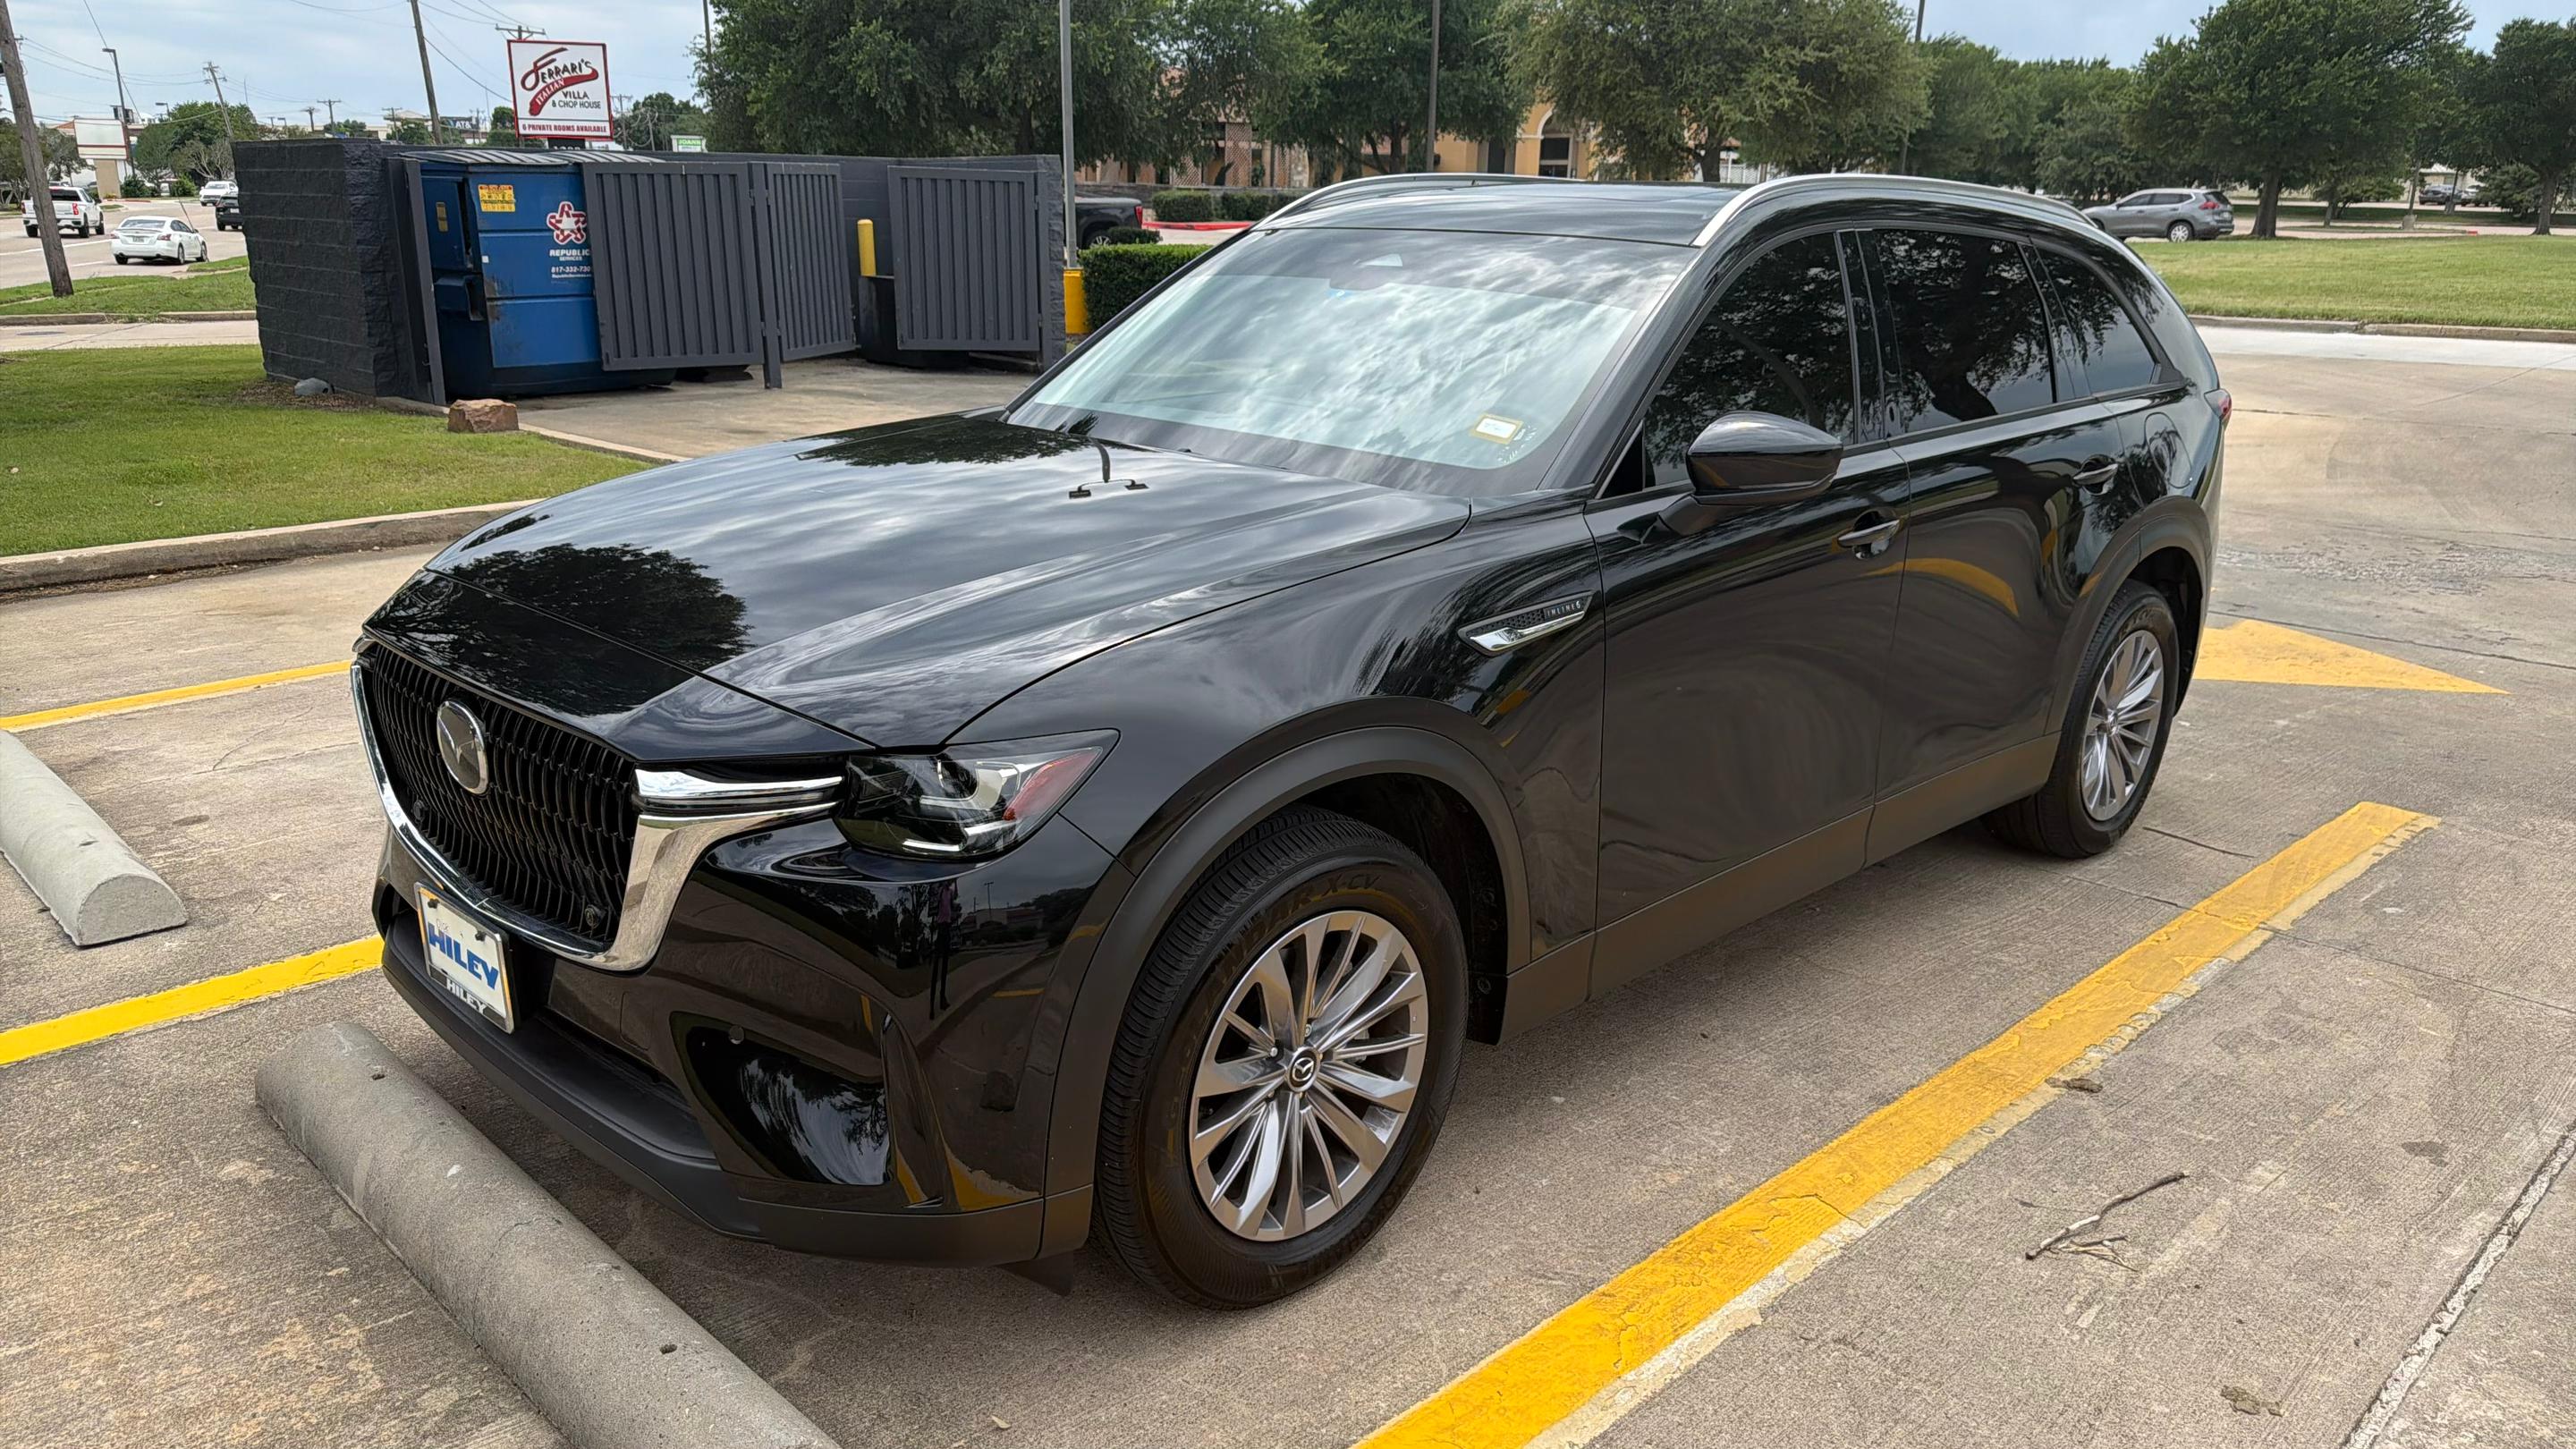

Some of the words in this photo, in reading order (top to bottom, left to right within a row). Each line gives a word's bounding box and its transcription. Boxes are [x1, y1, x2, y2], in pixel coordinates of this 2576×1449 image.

[535, 78, 565, 106] ITALIAN
[561, 90, 590, 99] VILLA
[552, 99, 556, 107] &
[558, 99, 578, 108] CHOP
[579, 100, 601, 109] HOUSE
[528, 123, 553, 131] PRIVATE
[554, 124, 575, 132] ROOMS
[576, 124, 607, 133] AVAILABLE
[549, 249, 590, 257] REPUBLIC
[428, 923, 499, 990] HILEY
[446, 978, 487, 1014] HILEY
